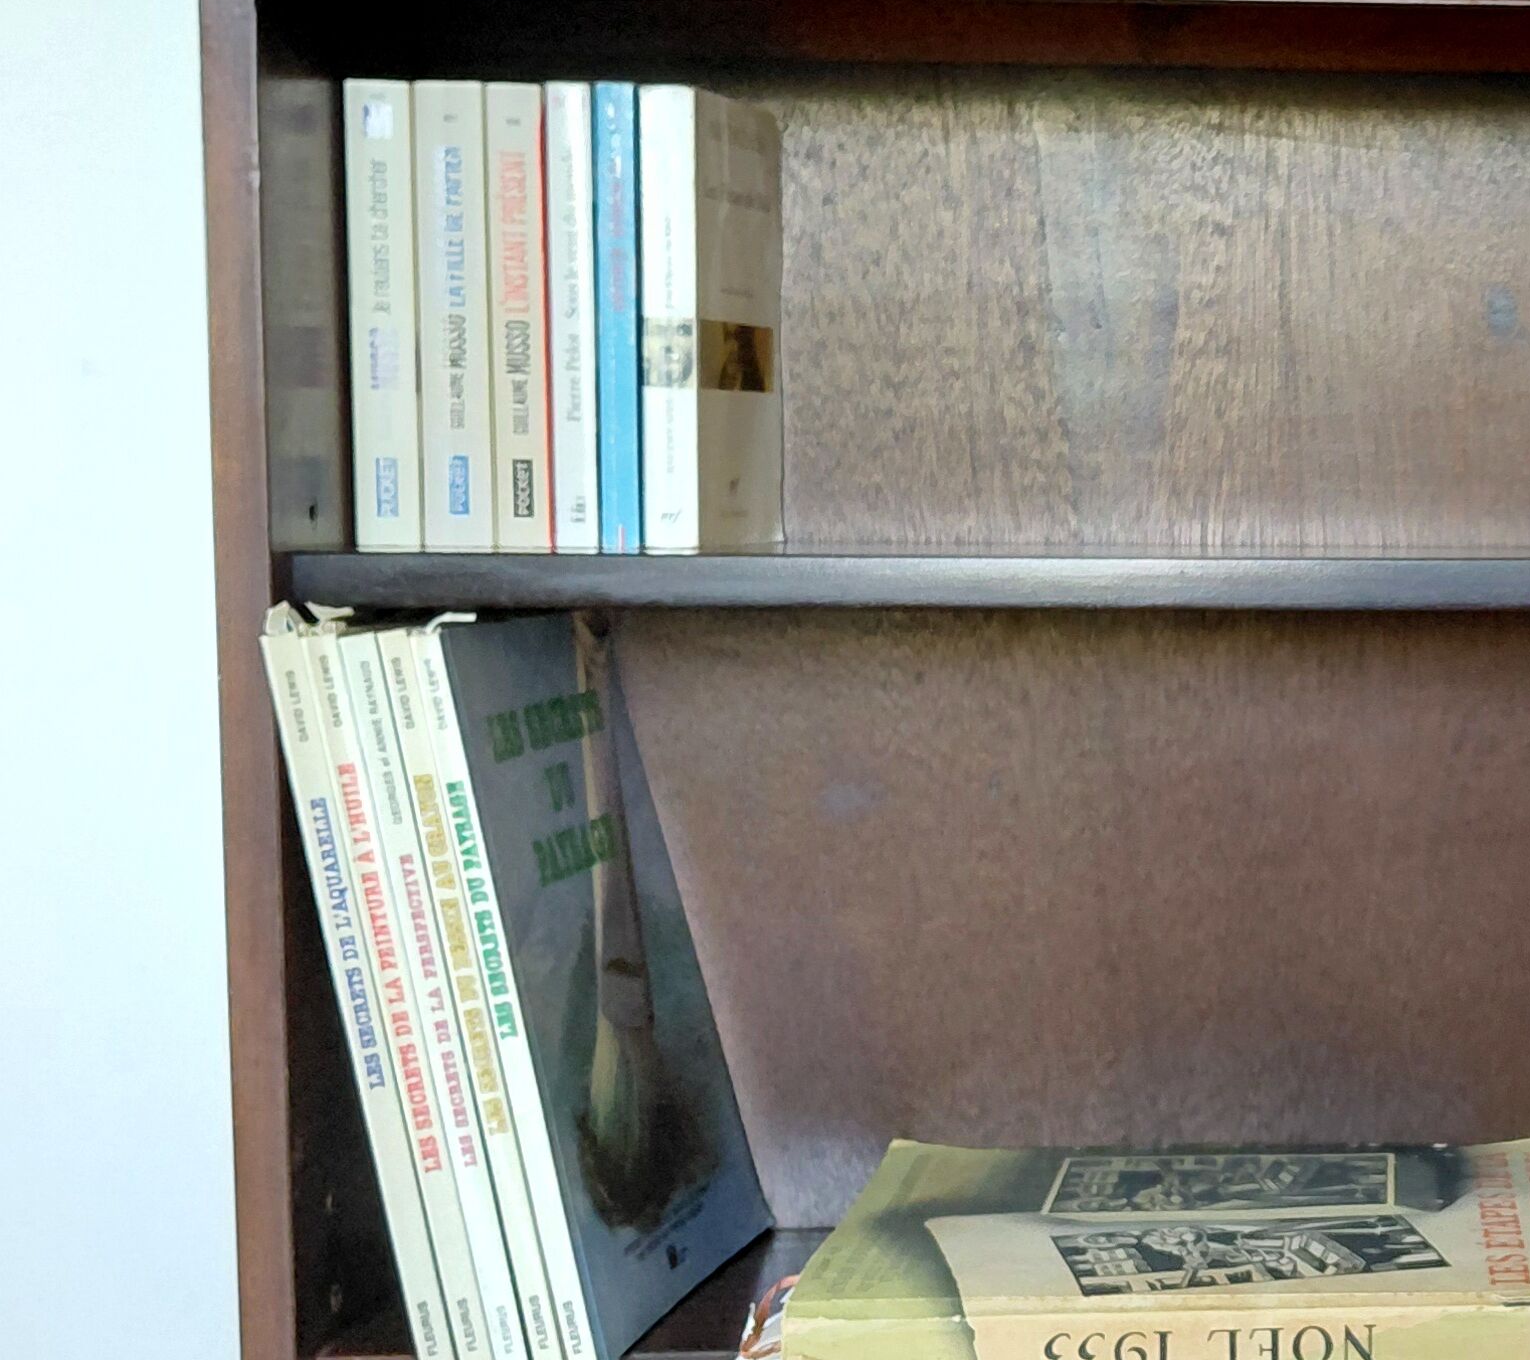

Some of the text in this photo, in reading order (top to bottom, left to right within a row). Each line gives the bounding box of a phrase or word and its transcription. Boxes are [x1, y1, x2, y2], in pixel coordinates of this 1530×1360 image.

[504, 320, 531, 375] MUSSO
[514, 461, 531, 517] POCKET
[285, 670, 309, 743] DAVID LEWIS
[318, 654, 342, 728] DAVID LEWIS
[390, 656, 415, 730] DAVID LEWIS
[446, 782, 518, 1040] LES SECRETS DU PAYSAGE
[310, 798, 385, 1090] LES SECRETS DE L'AQUARELLE
[336, 764, 442, 1173] LES SECRETS DE LA PEINTURE À L'HUILE
[399, 854, 478, 1167] LES SECRETS DE LA PERSPECTIVE
[1476, 1192, 1526, 1249] ÉTAPES
[417, 1301, 437, 1357] FLEURUS
[456, 1298, 477, 1352] FLEURUS
[528, 1295, 549, 1350] FLEURUS
[562, 1300, 582, 1355] FLEURUS
